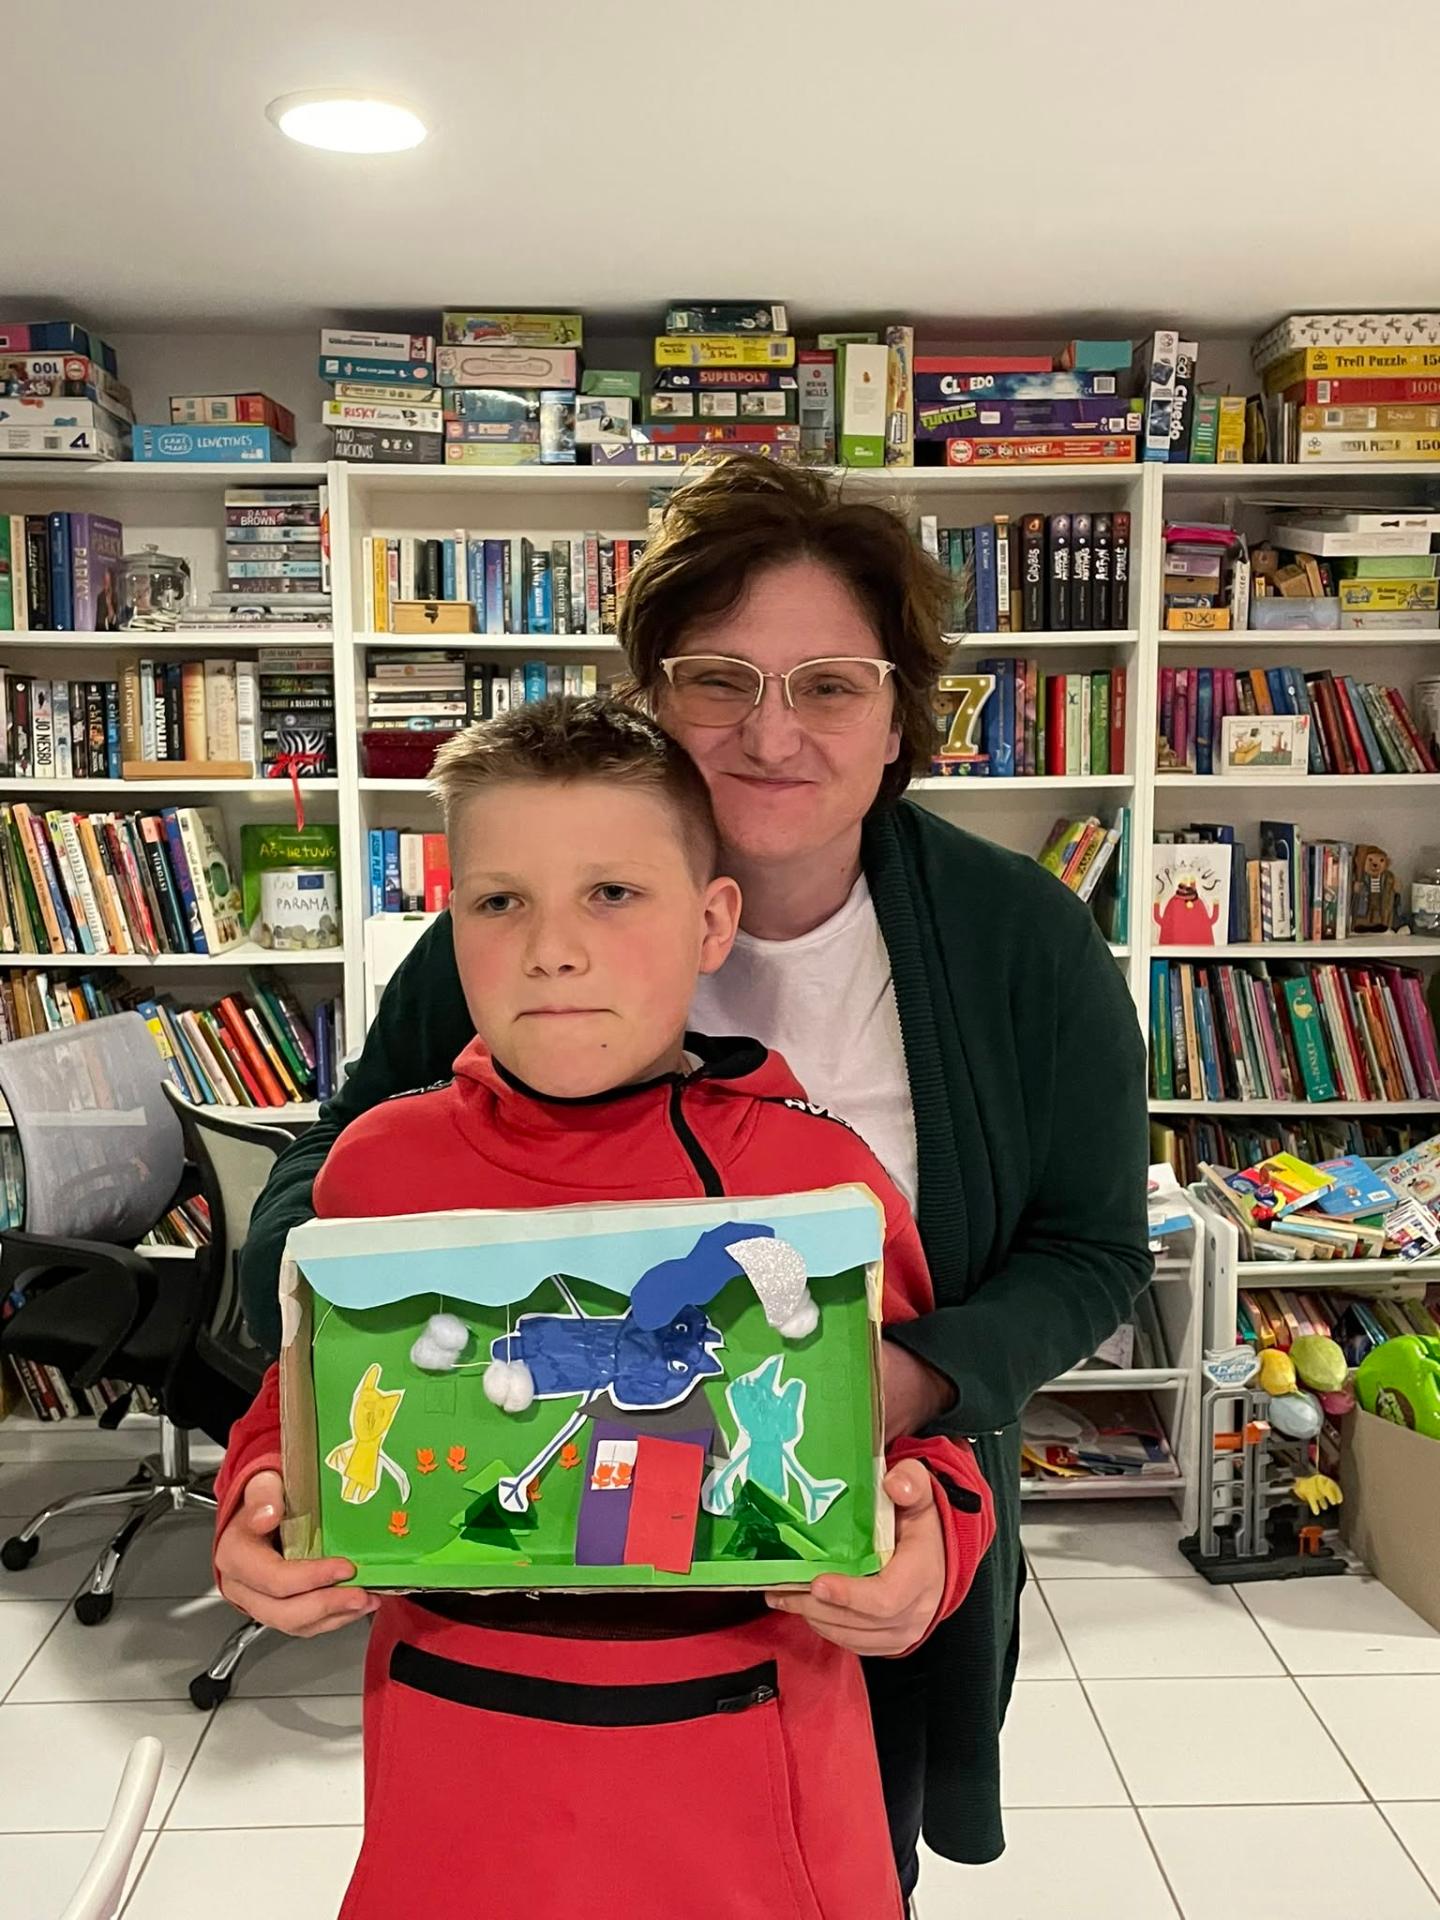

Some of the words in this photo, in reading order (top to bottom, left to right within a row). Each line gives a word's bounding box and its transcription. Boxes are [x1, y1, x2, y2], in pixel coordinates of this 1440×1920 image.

[699, 372, 768, 384] SUPERPOLY
[940, 375, 994, 396] CLUEDO
[344, 406, 376, 420] RISKY
[919, 406, 978, 430] TURTLES
[1170, 385, 1188, 440] Cluedo
[240, 516, 276, 525] BROWN
[247, 509, 268, 517] DAN
[556, 566, 568, 613] Historian
[34, 718, 50, 731] JO
[123, 689, 134, 743] Greenspan
[938, 674, 996, 756] 7
[156, 697, 168, 760] HITMAN
[152, 851, 168, 892] ISTORIJA
[276, 897, 330, 912] PARAMA
